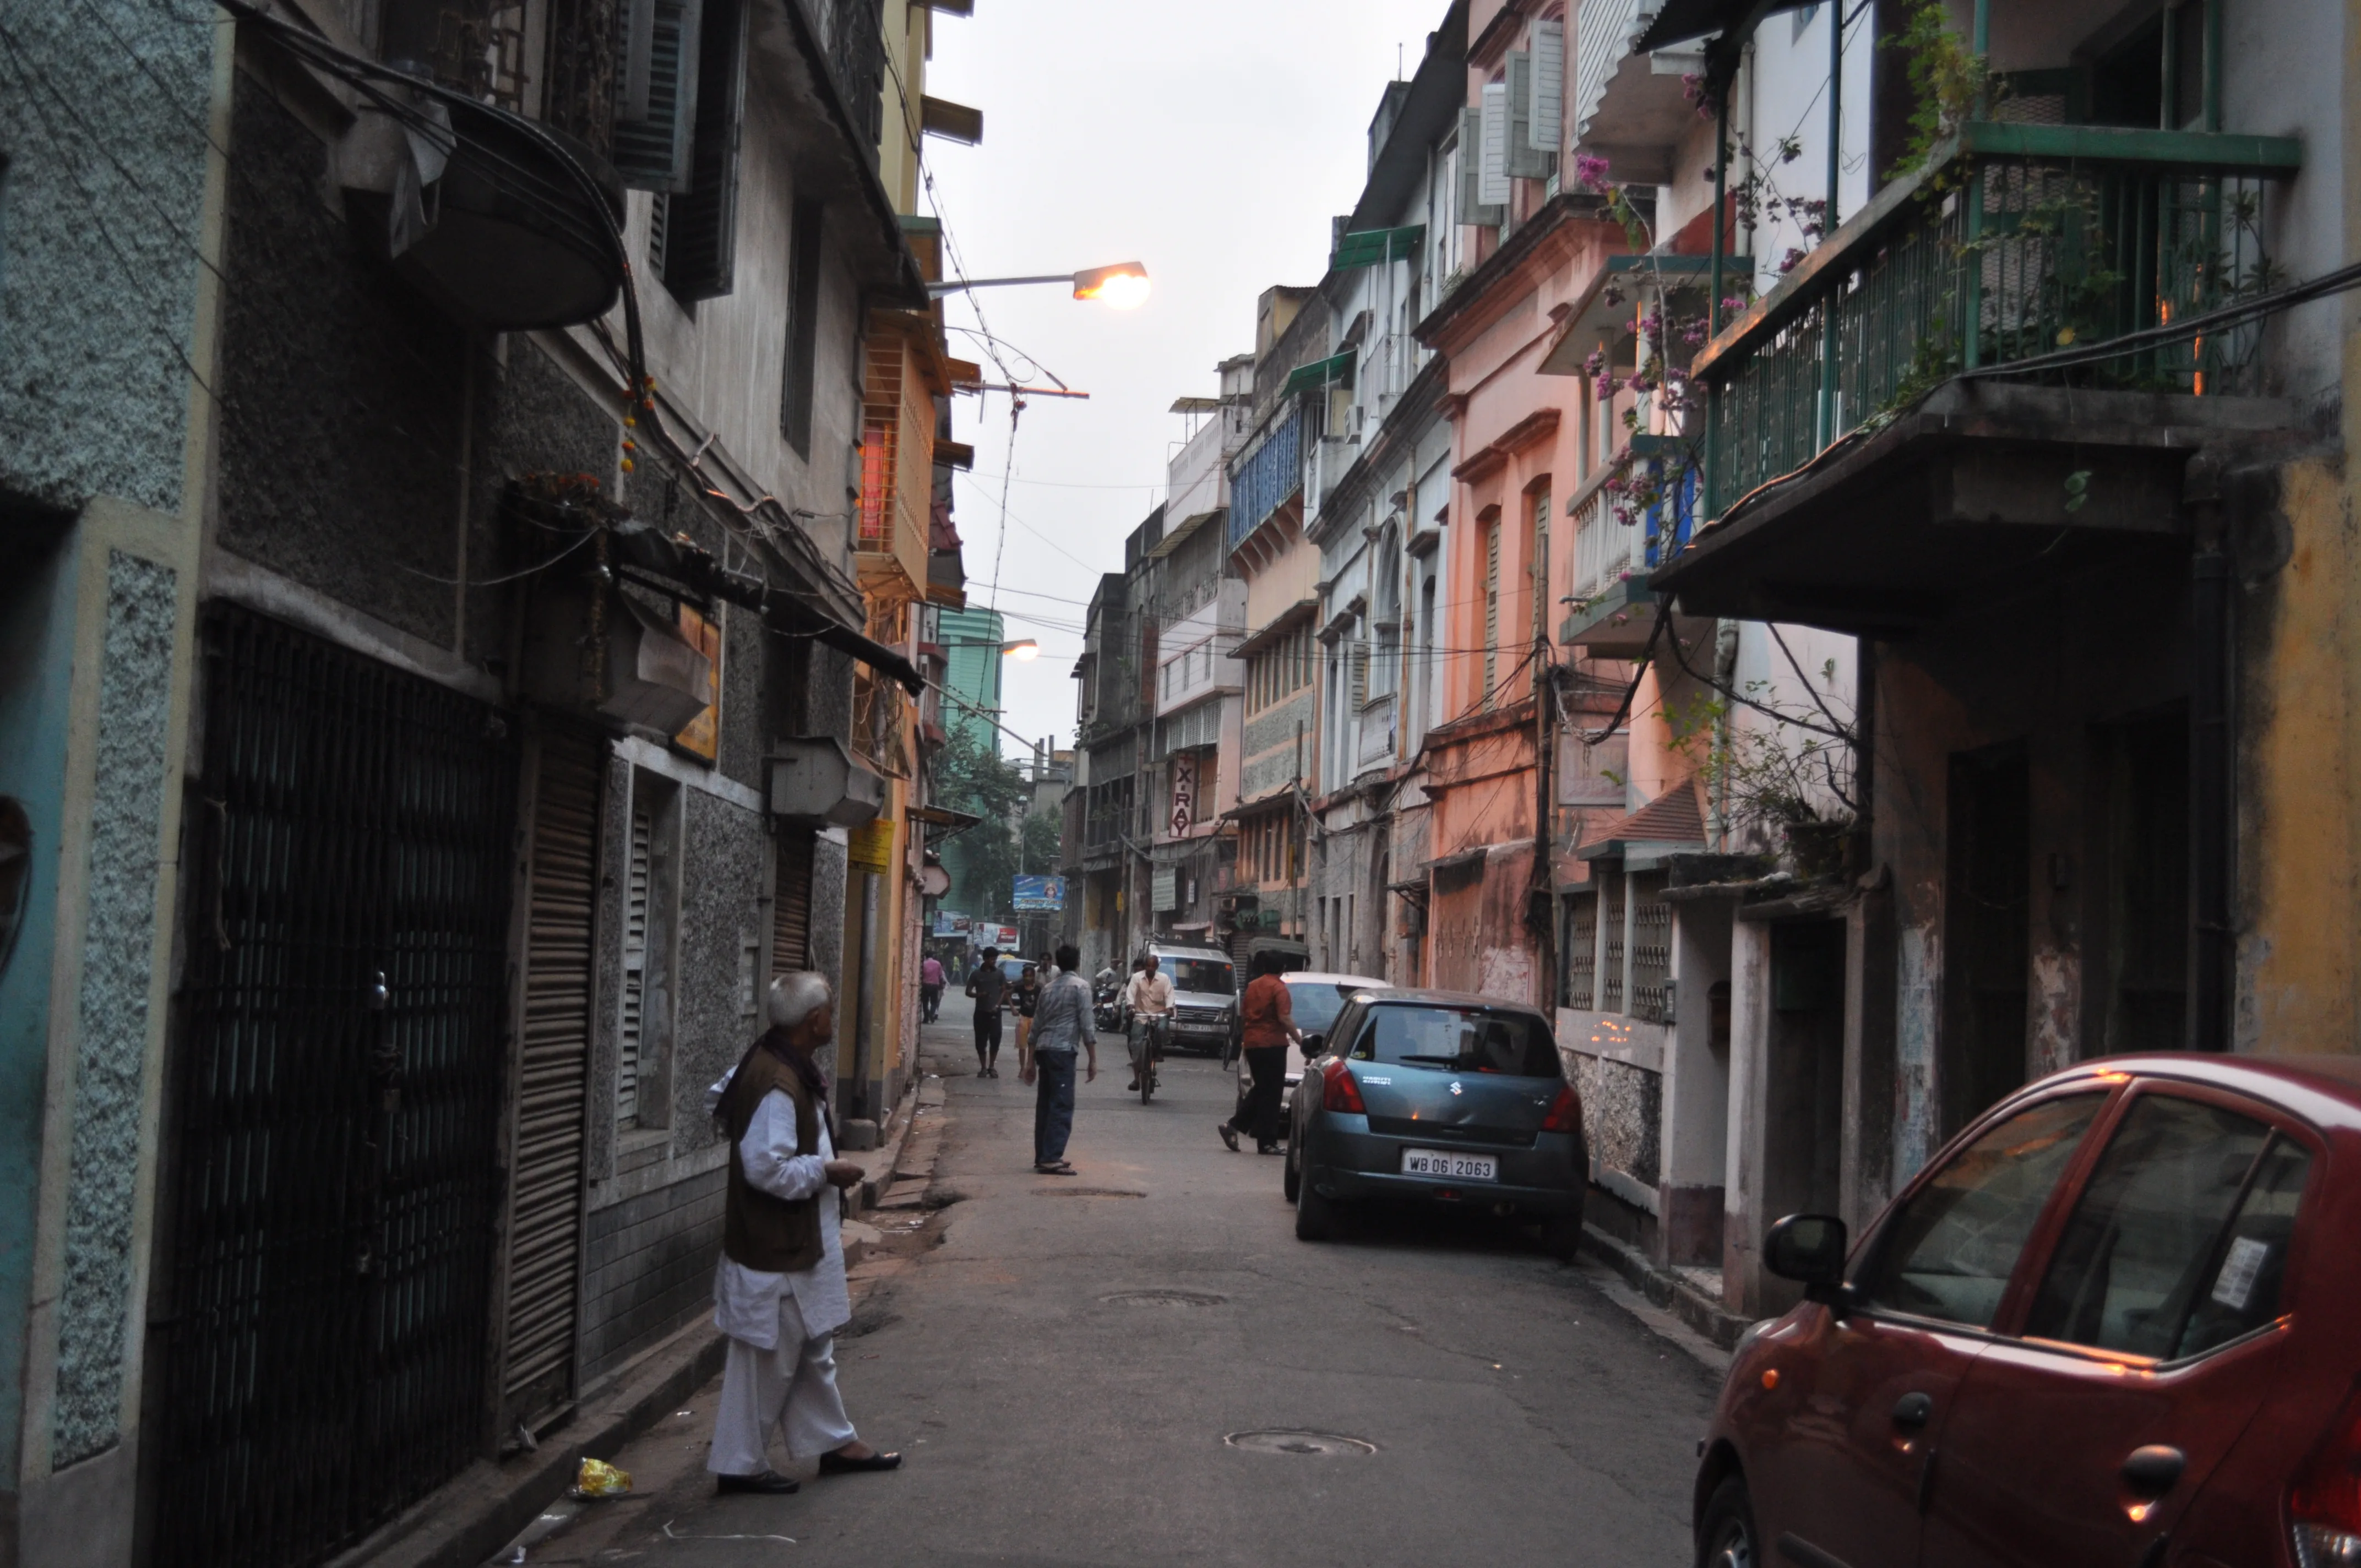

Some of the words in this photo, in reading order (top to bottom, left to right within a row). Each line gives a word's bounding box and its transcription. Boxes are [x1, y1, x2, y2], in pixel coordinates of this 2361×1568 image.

[1174, 767, 1192, 837] X-RAY
[1410, 1157, 1428, 1172] WB
[1432, 1159, 1448, 1173] 06
[1456, 1161, 1490, 1177] 2063
